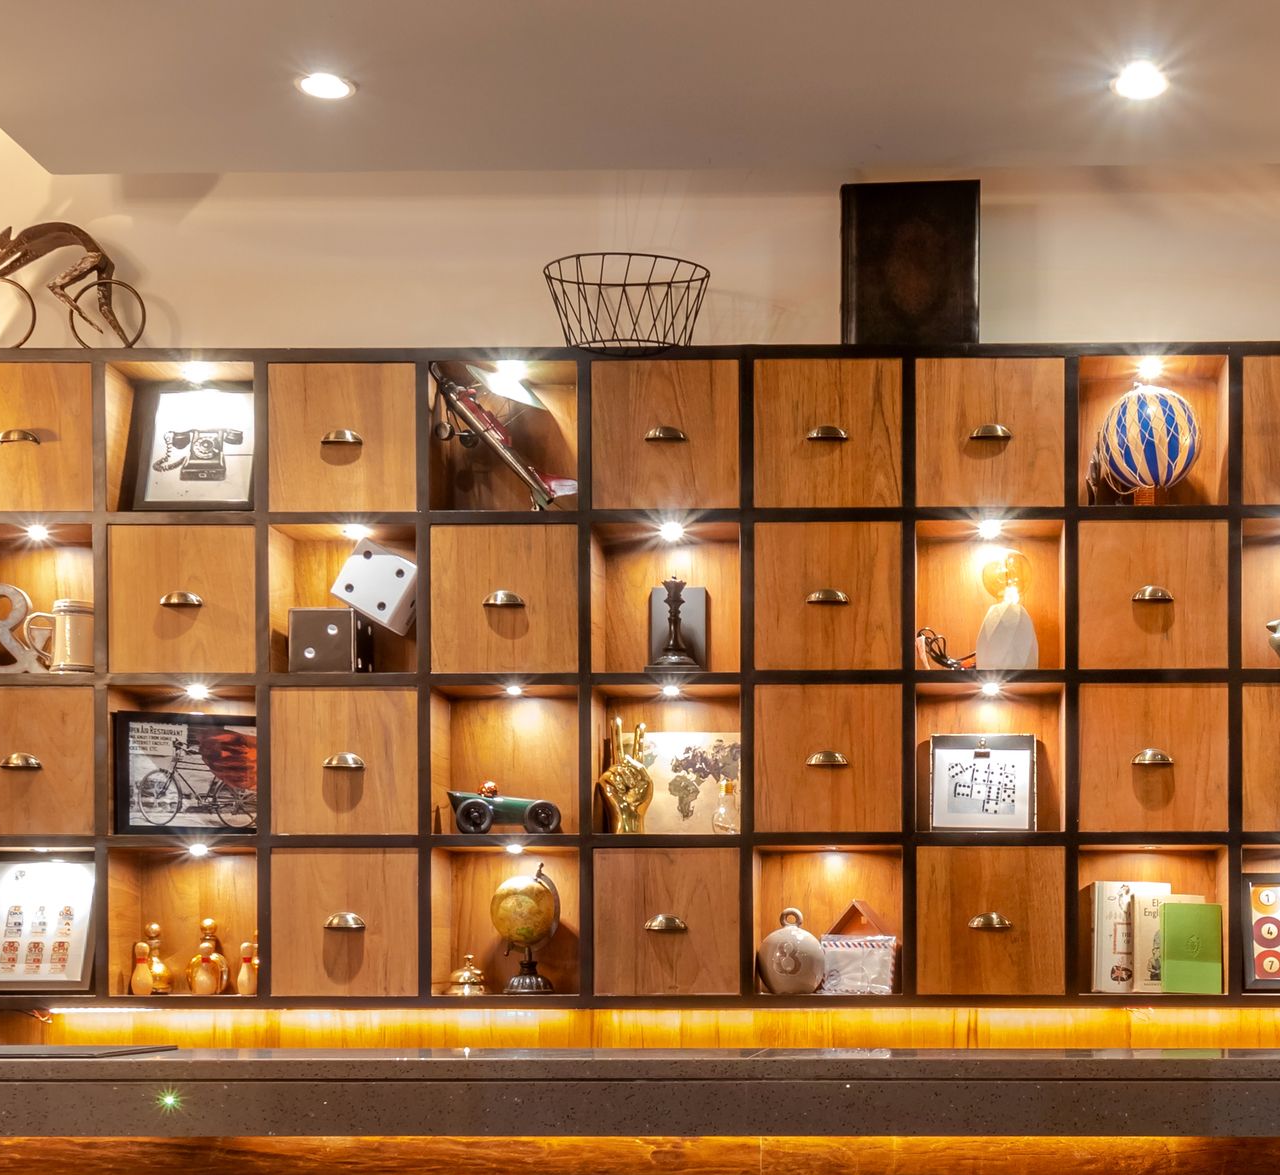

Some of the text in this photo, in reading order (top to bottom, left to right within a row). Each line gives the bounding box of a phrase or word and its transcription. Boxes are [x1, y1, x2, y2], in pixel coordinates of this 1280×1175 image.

[150, 726, 183, 737] RESTAURANT
[1265, 894, 1270, 902] 1
[1267, 926, 1273, 936] 4
[773, 941, 802, 975] 8
[1268, 960, 1274, 970] 7
